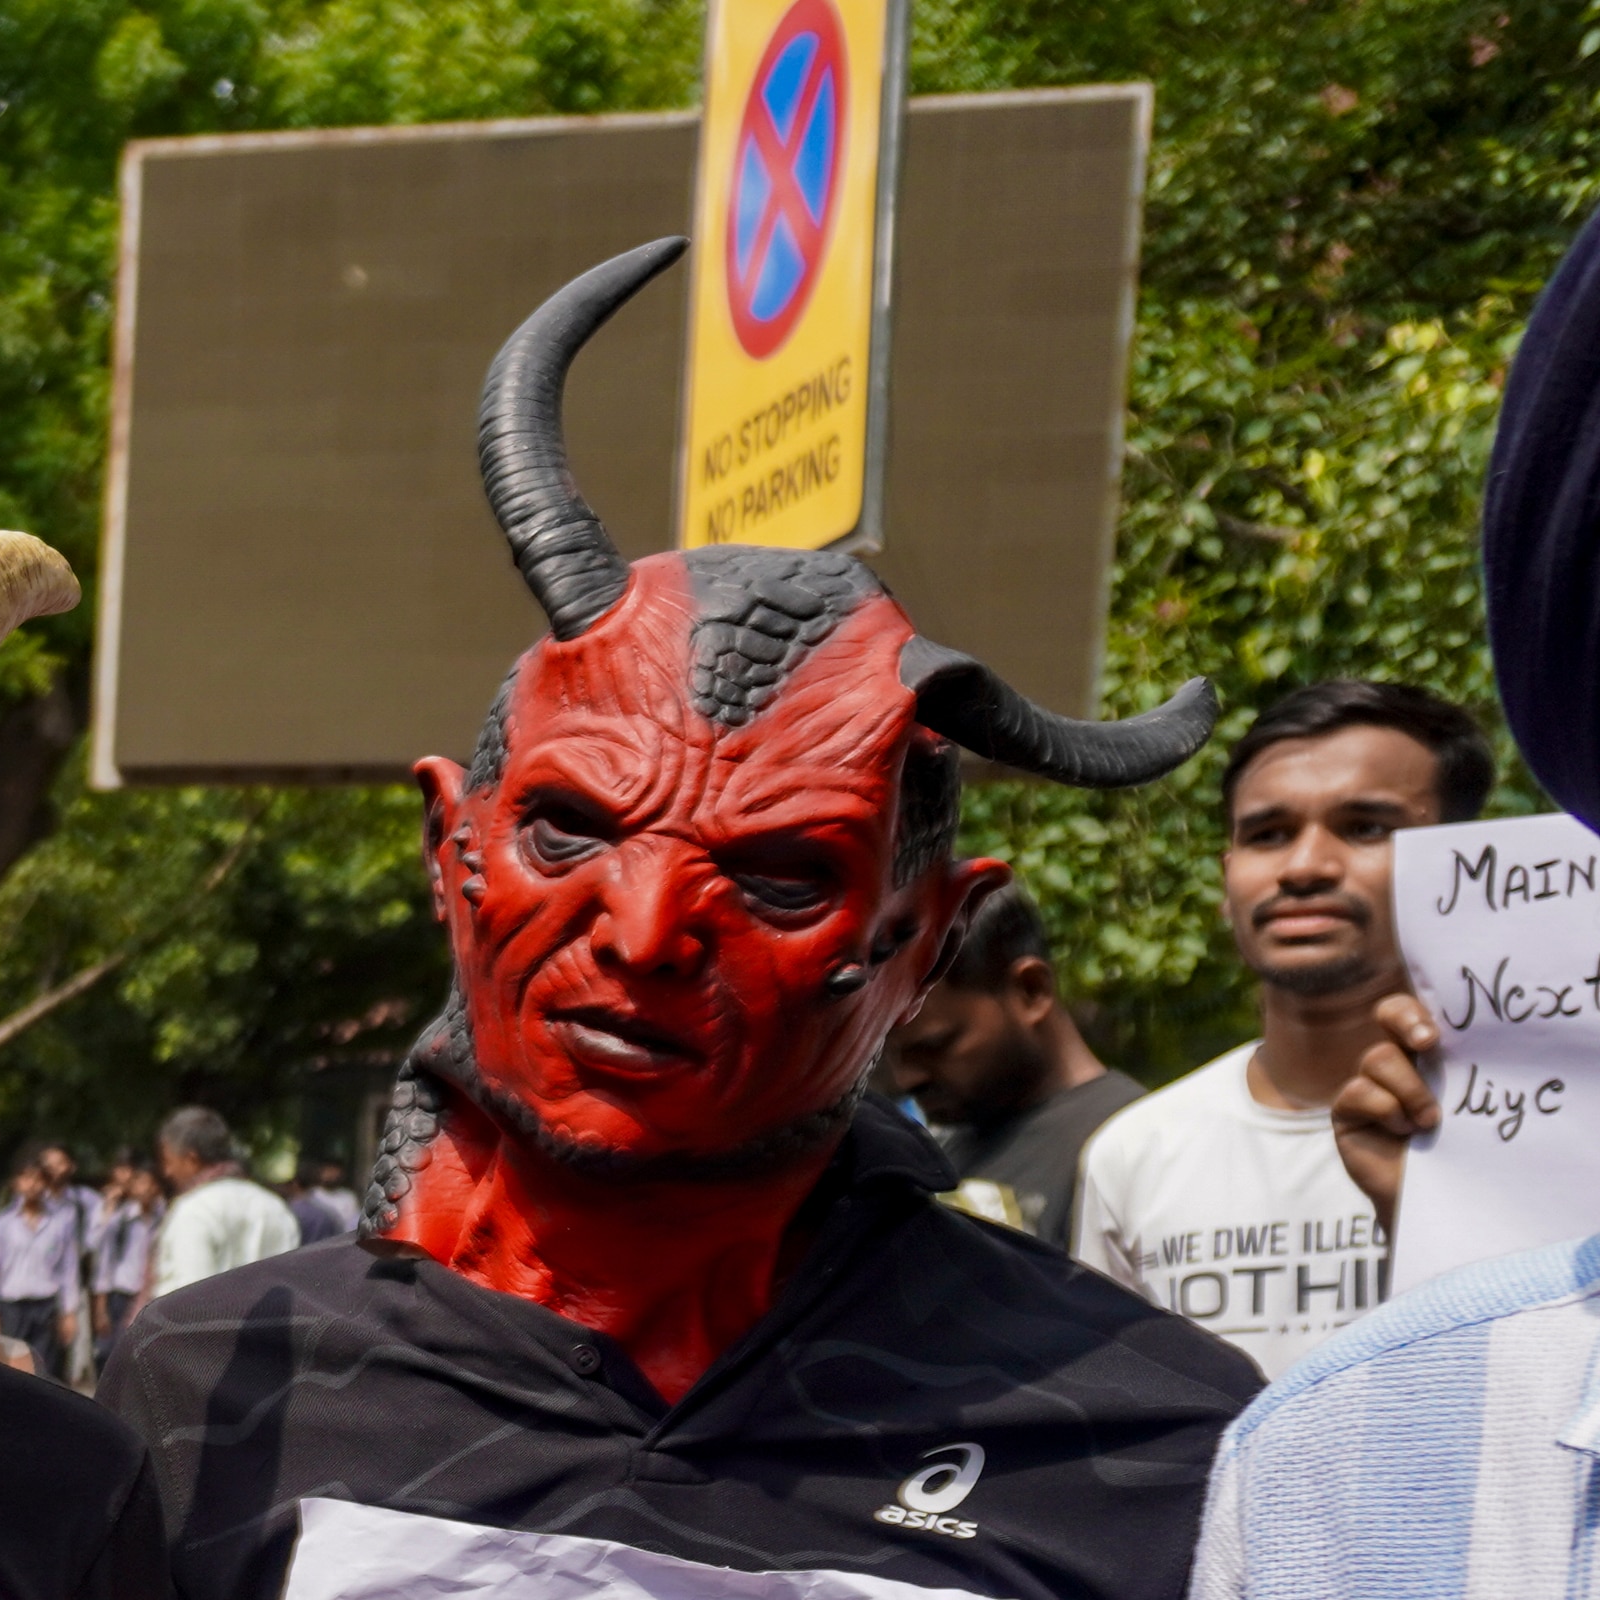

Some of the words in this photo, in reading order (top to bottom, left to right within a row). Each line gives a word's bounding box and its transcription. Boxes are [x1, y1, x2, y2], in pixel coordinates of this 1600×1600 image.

[703, 434, 733, 485] NO
[736, 355, 853, 466] STOPPING
[706, 497, 736, 545] NO
[741, 433, 841, 528] PARKING
[1437, 844, 1597, 915] MAIN
[1162, 1231, 1204, 1267] WE
